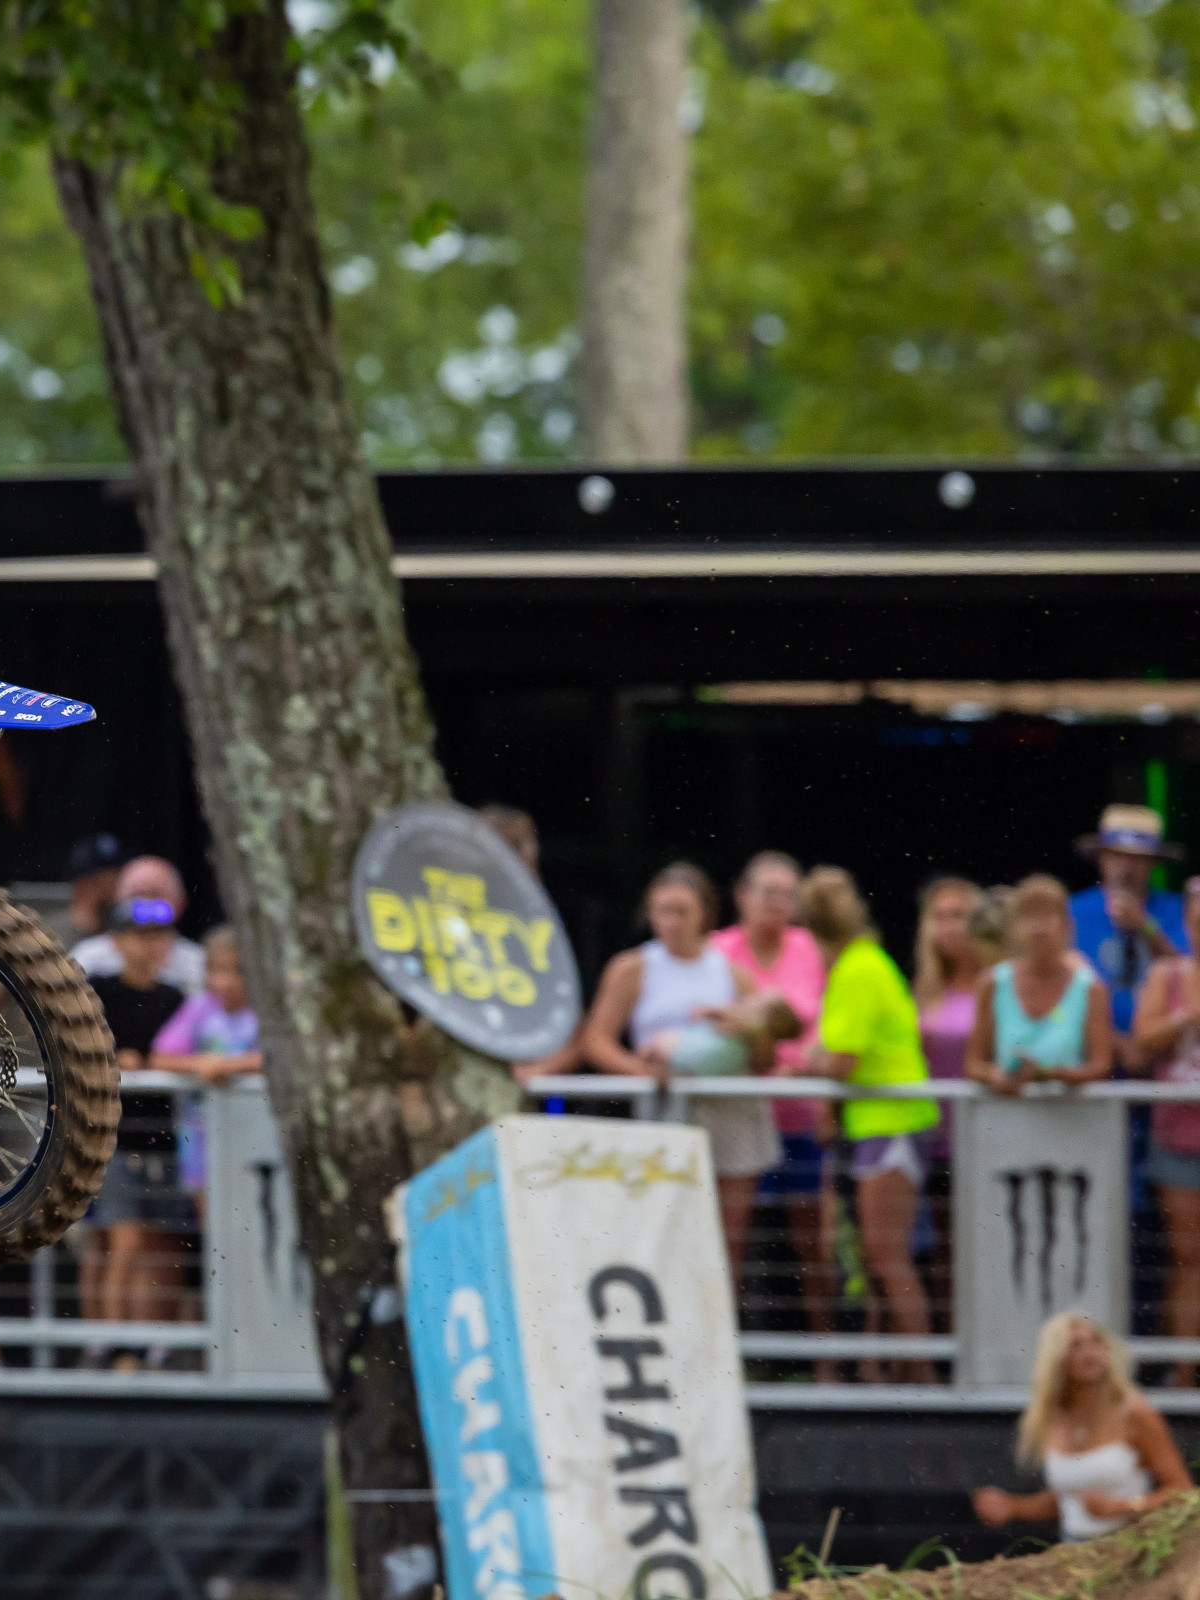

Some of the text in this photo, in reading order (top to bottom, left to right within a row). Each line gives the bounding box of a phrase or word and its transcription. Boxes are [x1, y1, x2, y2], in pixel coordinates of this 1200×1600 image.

[422, 866, 486, 912] THE
[366, 885, 556, 973] DIRTY
[425, 955, 539, 1008] 100
[443, 1286, 528, 1600] CHAR
